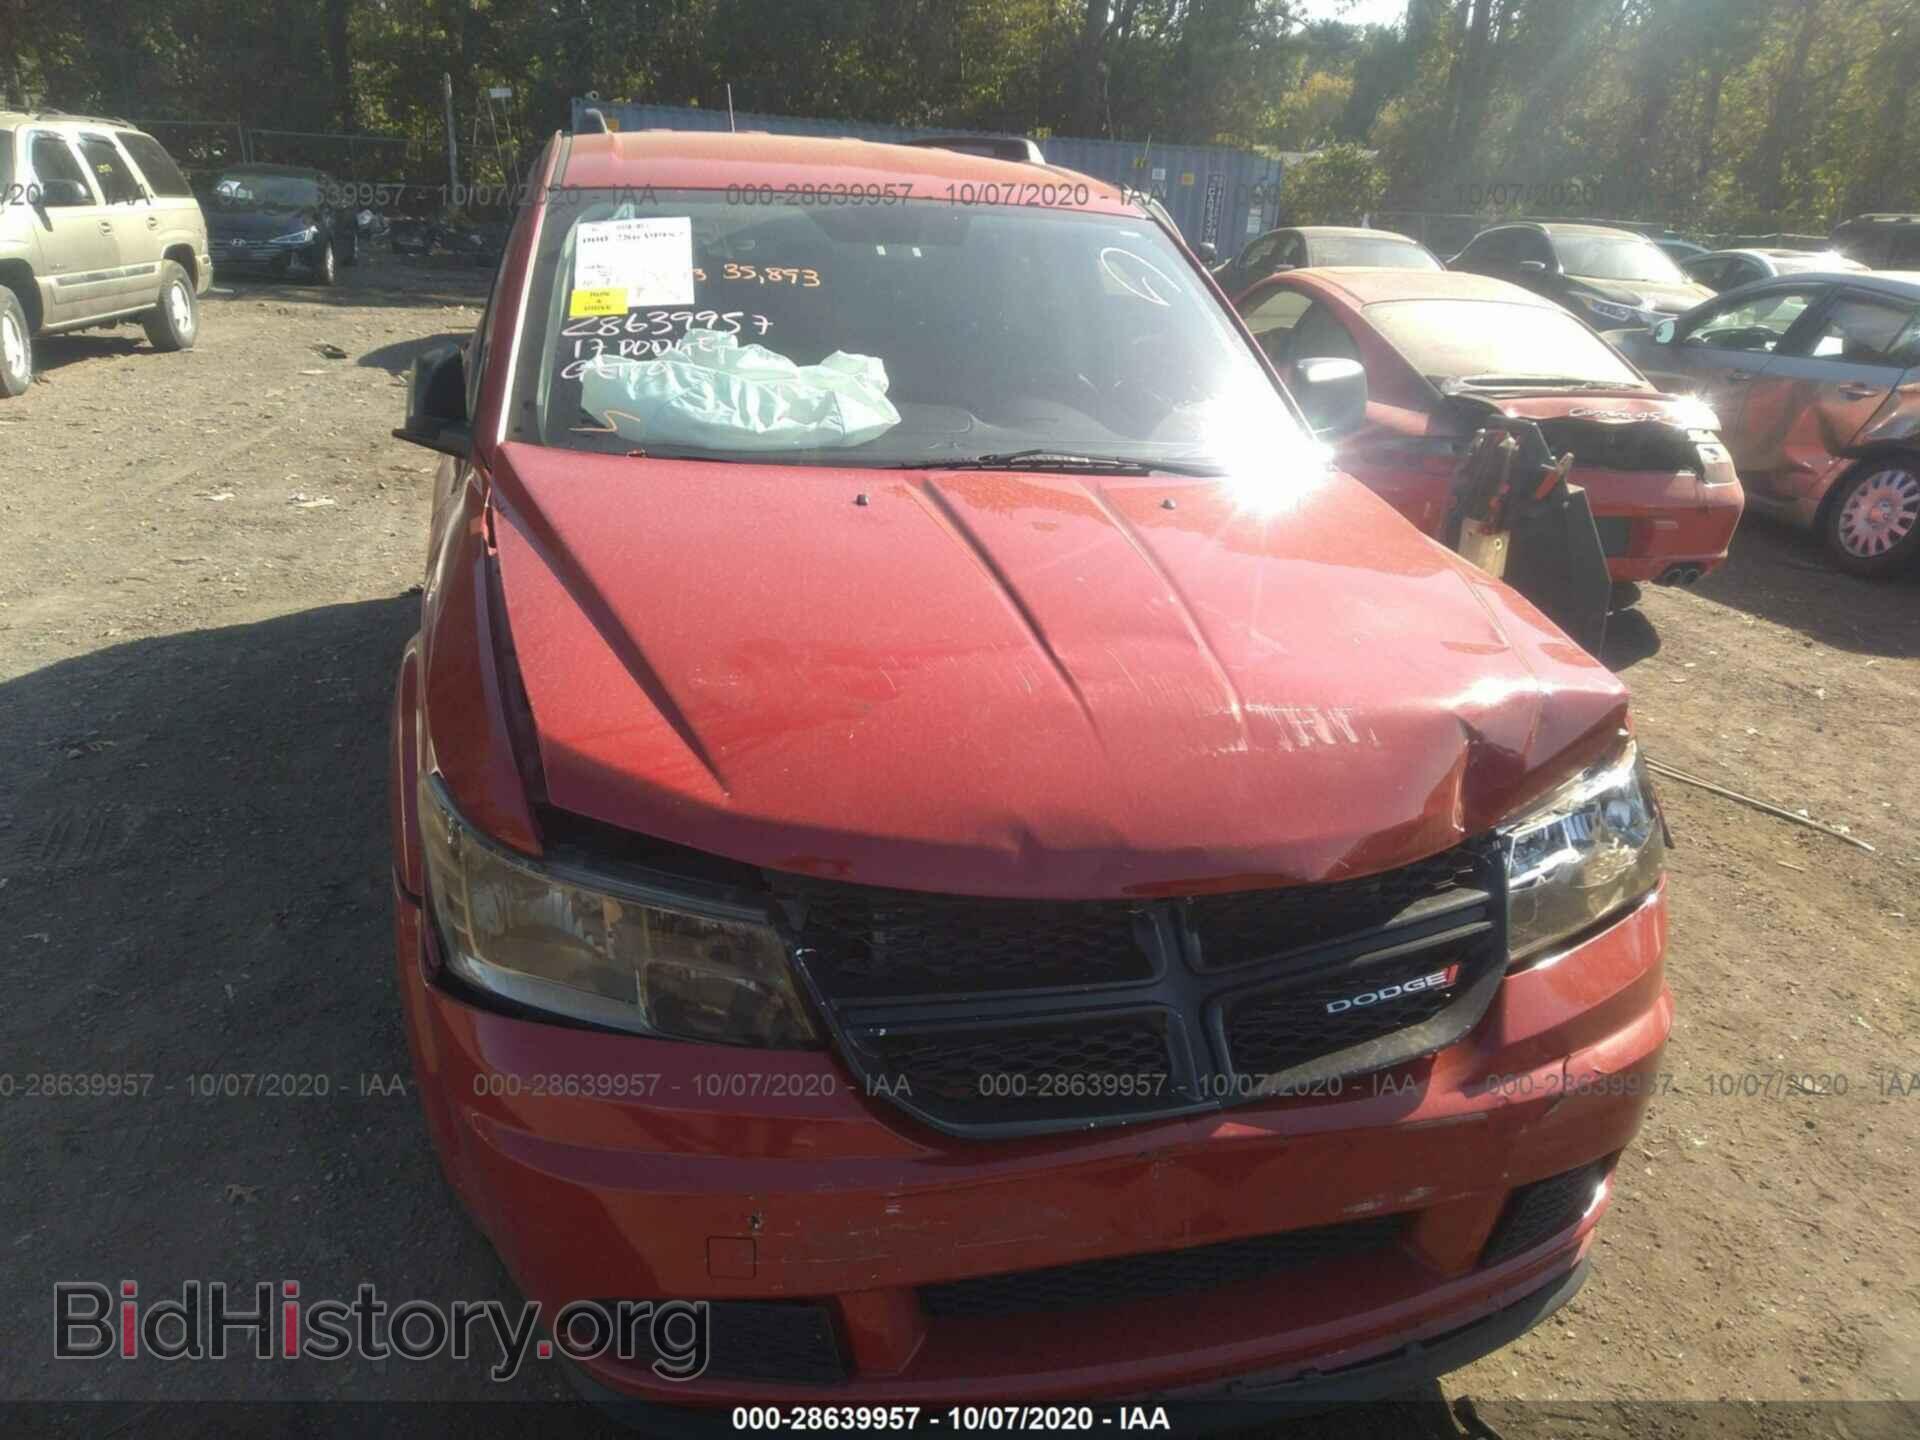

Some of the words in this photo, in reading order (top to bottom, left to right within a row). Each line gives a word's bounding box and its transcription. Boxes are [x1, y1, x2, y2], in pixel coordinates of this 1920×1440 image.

[723, 263, 821, 287] 35,893
[561, 311, 774, 337] 28639957
[1325, 970, 1448, 1014] DODGE
